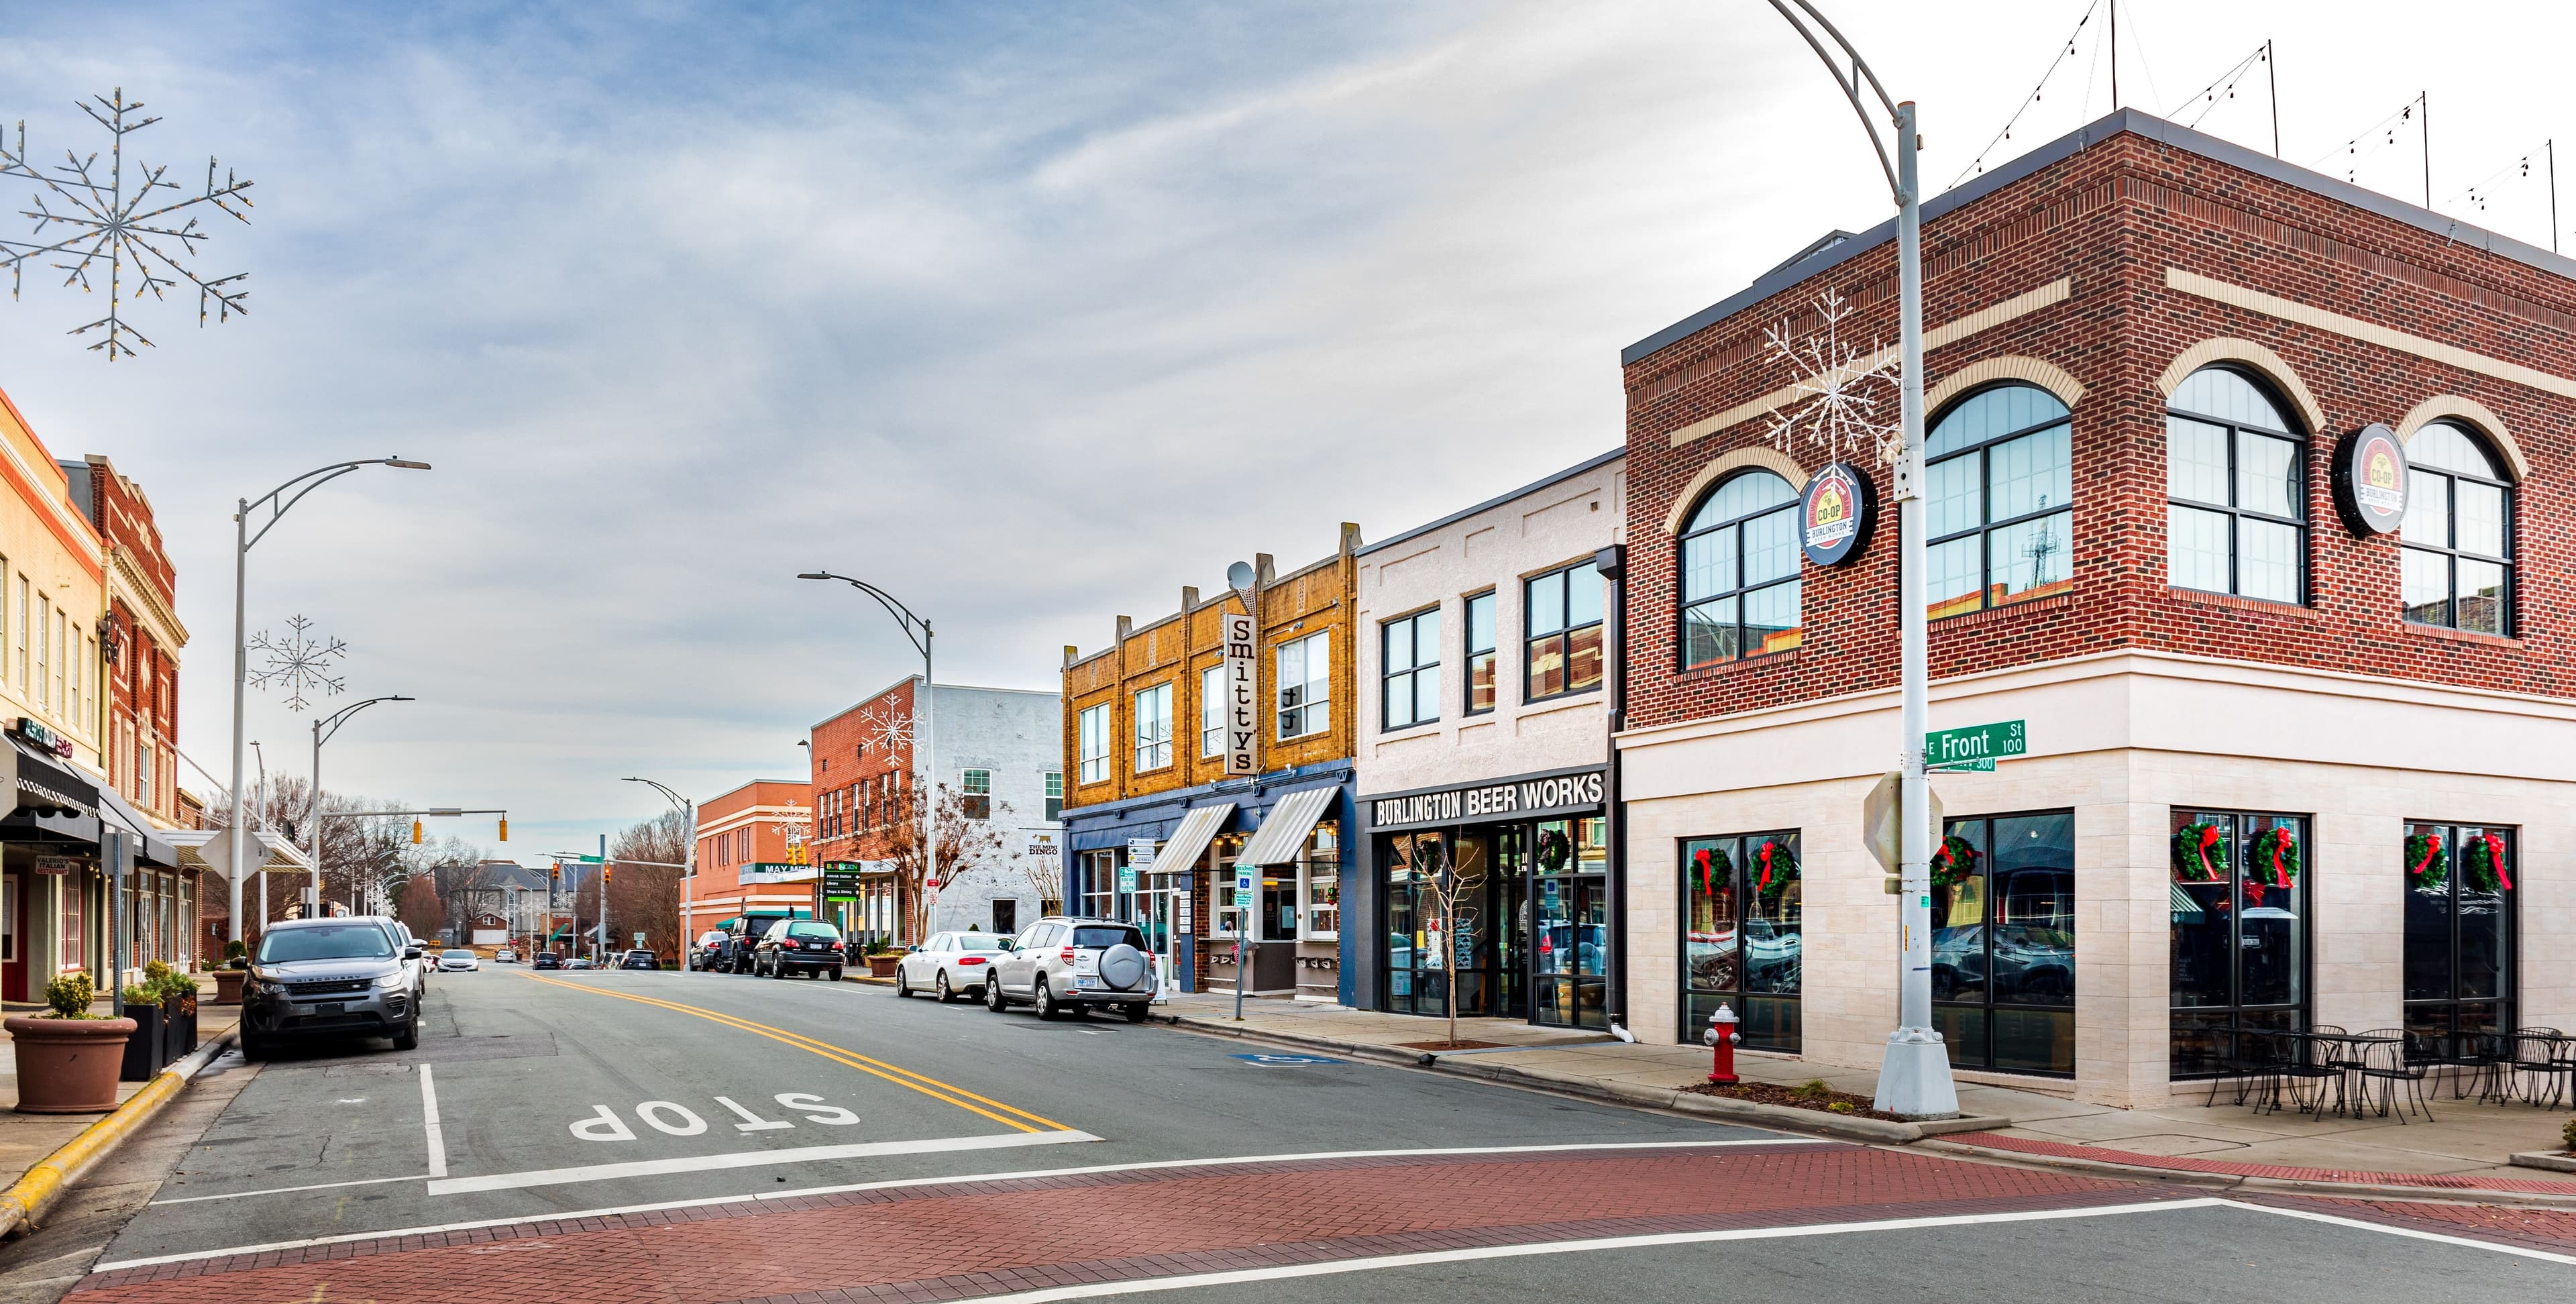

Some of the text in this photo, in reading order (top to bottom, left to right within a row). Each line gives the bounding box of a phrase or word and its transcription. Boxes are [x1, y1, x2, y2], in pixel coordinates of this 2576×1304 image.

[2371, 469, 2392, 485] CO-OP
[2366, 488, 2398, 503] BURLINGTON
[1817, 504, 1841, 521] CO-OP
[1812, 521, 1847, 538] BURLINGTON
[1229, 620, 1256, 770] Smitty's
[1929, 723, 2022, 759] E Front St
[2003, 739, 2023, 753] 100
[1976, 759, 1992, 769] 300
[1377, 773, 1603, 826] BURLINGTON BEER WORKS
[765, 865, 788, 873] MAY
[296, 975, 361, 983] DISCOVERY
[568, 1092, 861, 1141] STOP
